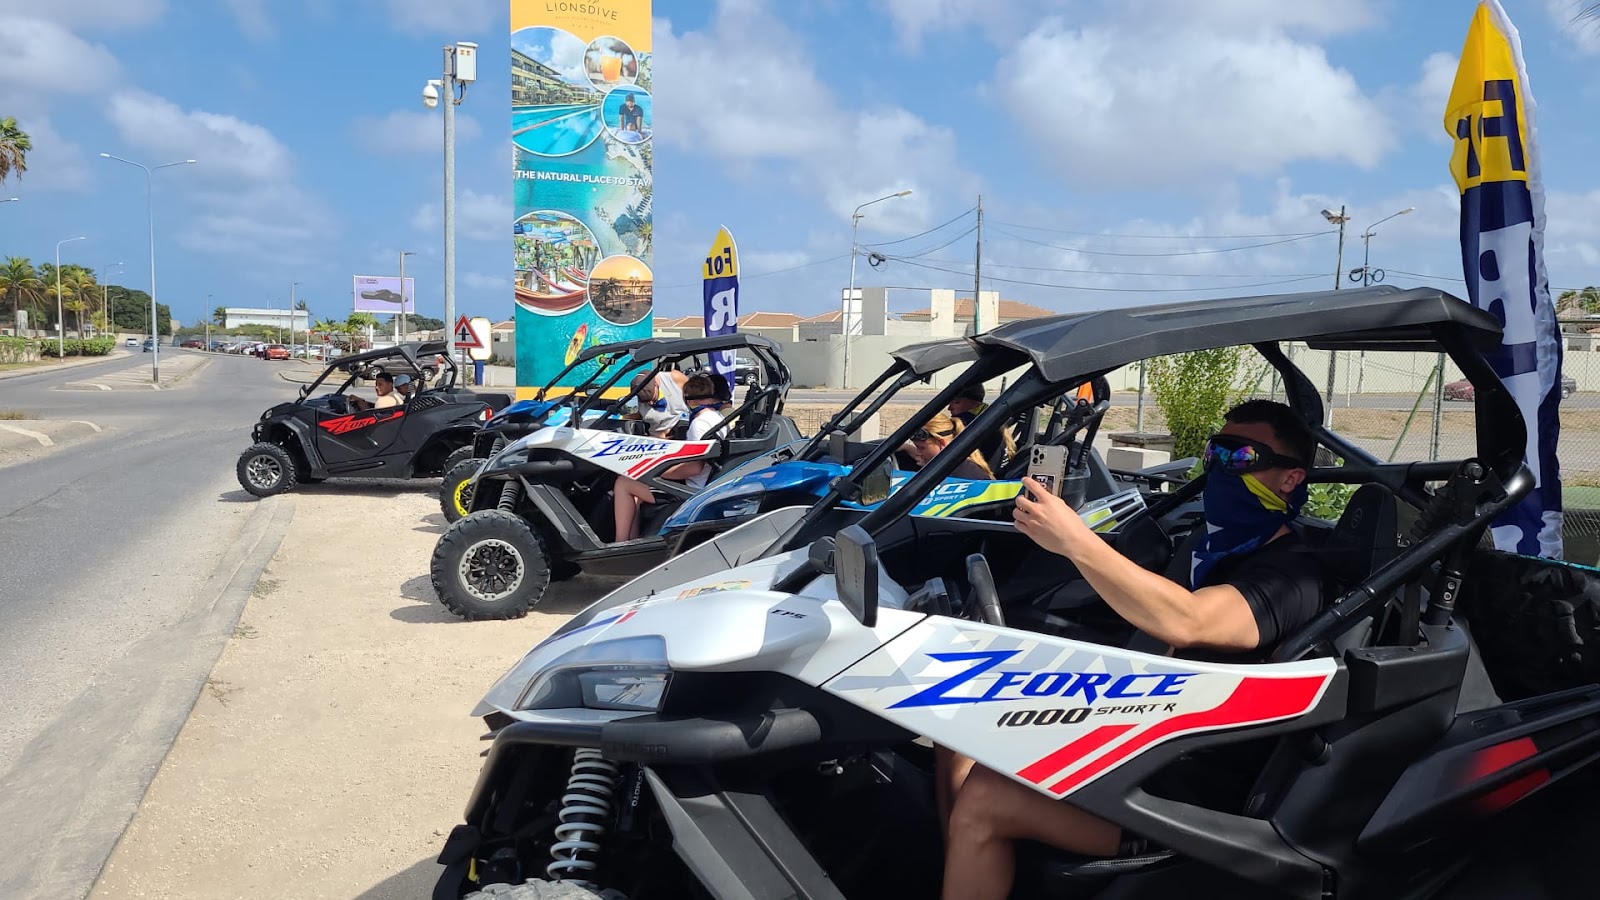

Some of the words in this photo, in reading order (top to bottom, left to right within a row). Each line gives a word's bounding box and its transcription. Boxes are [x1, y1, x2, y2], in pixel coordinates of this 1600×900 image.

[546, 2, 618, 20] LIONSDIVE
[516, 170, 536, 179] THE
[537, 171, 582, 182] NATURAL
[583, 175, 612, 184] PLACE
[612, 177, 626, 185] TO
[627, 178, 649, 186] STAY
[618, 453, 643, 461] 1000
[997, 707, 1092, 728] 1000
[1097, 703, 1160, 716] SPORT
[1163, 702, 1177, 714] R
